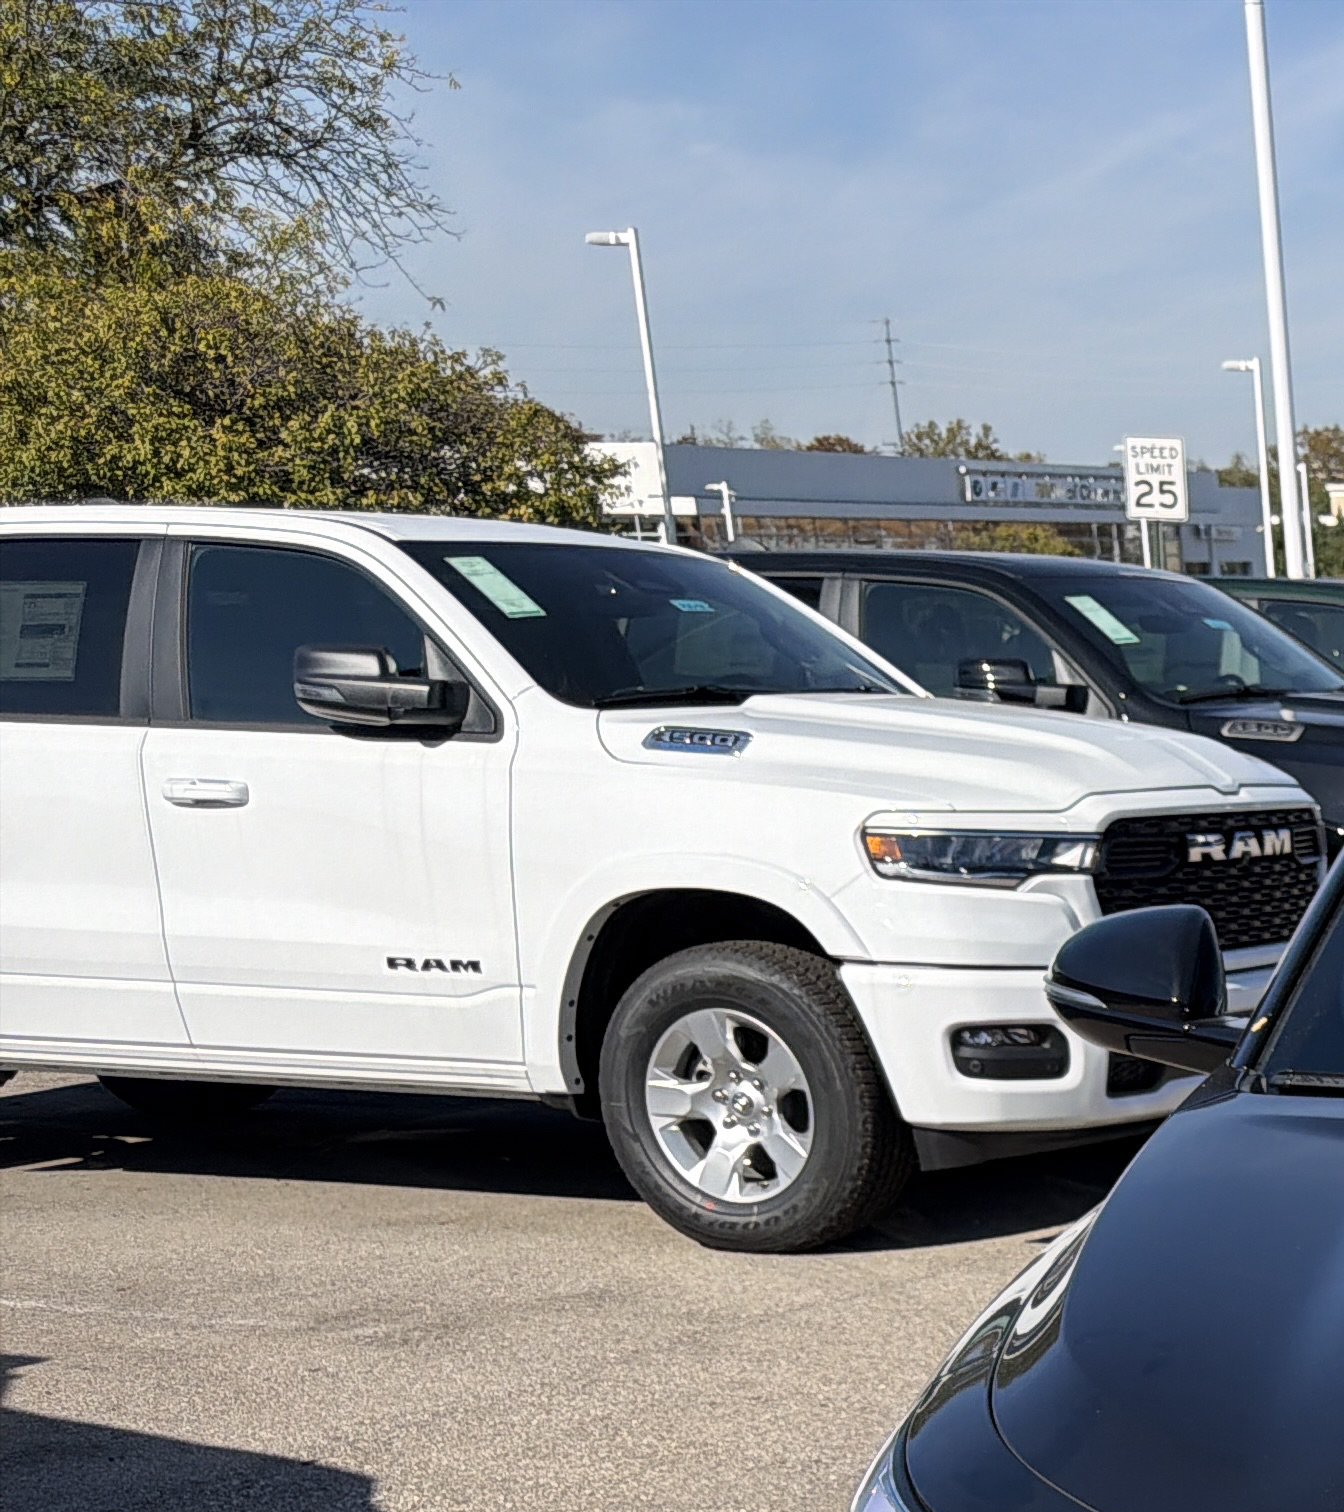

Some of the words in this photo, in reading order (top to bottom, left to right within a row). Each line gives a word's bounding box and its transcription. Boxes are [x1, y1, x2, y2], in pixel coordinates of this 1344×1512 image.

[1130, 445, 1179, 460] SPEED
[1135, 463, 1174, 475] LIMIT
[1134, 480, 1178, 509] 25
[1186, 829, 1292, 862] RAM
[386, 957, 482, 974] RAM
